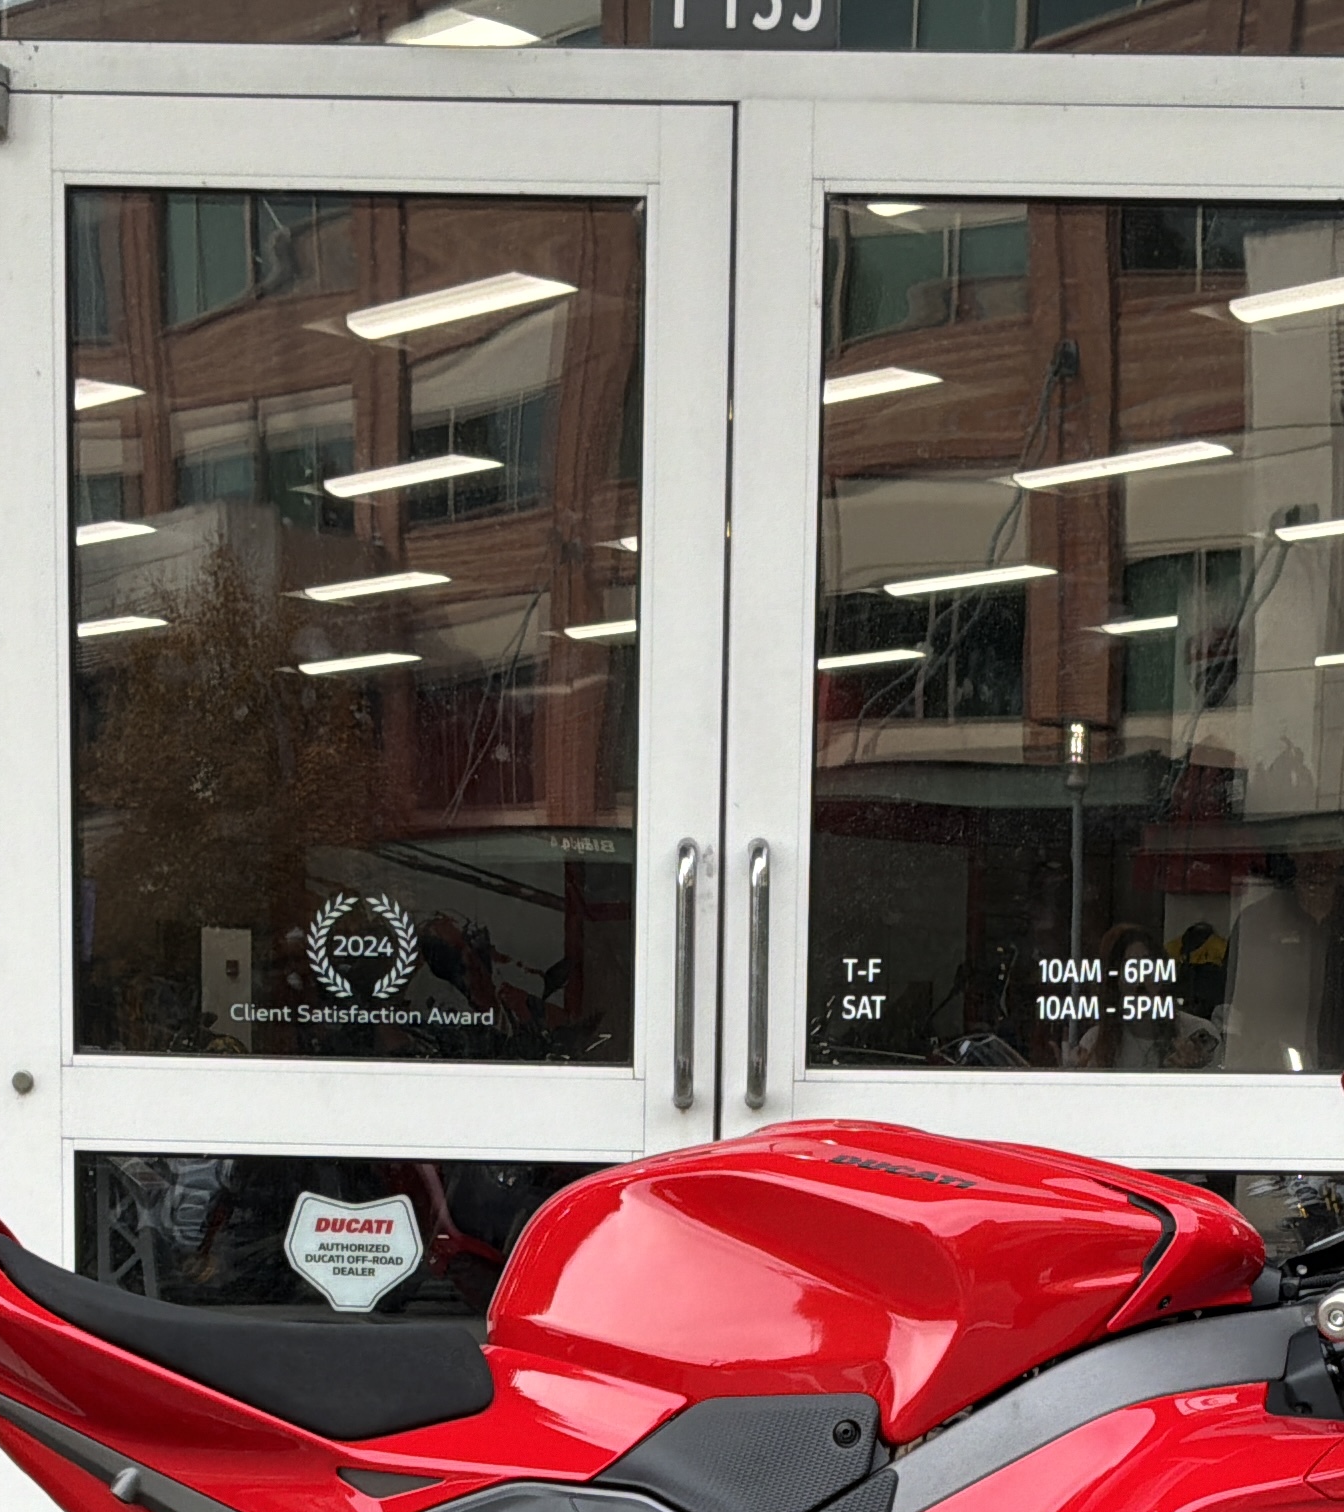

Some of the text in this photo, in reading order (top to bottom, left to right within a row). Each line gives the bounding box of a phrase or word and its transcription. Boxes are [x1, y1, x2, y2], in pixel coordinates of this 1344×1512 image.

[333, 936, 393, 957] 2024
[843, 958, 882, 983] T-F
[1038, 958, 1102, 983] 10AM
[1123, 958, 1177, 983] 6PM
[230, 1003, 494, 1025] Client Satisfaction Award
[841, 995, 886, 1020] SAT
[1036, 995, 1100, 1020] 10AM
[1122, 995, 1174, 1020] 5PM
[829, 1154, 977, 1189] DUCATI
[314, 1217, 395, 1235] DUCATI
[318, 1242, 391, 1253] AUTHORIZED
[305, 1253, 404, 1266] DUCATI OFF-ROAD
[332, 1266, 376, 1277] DEALER
